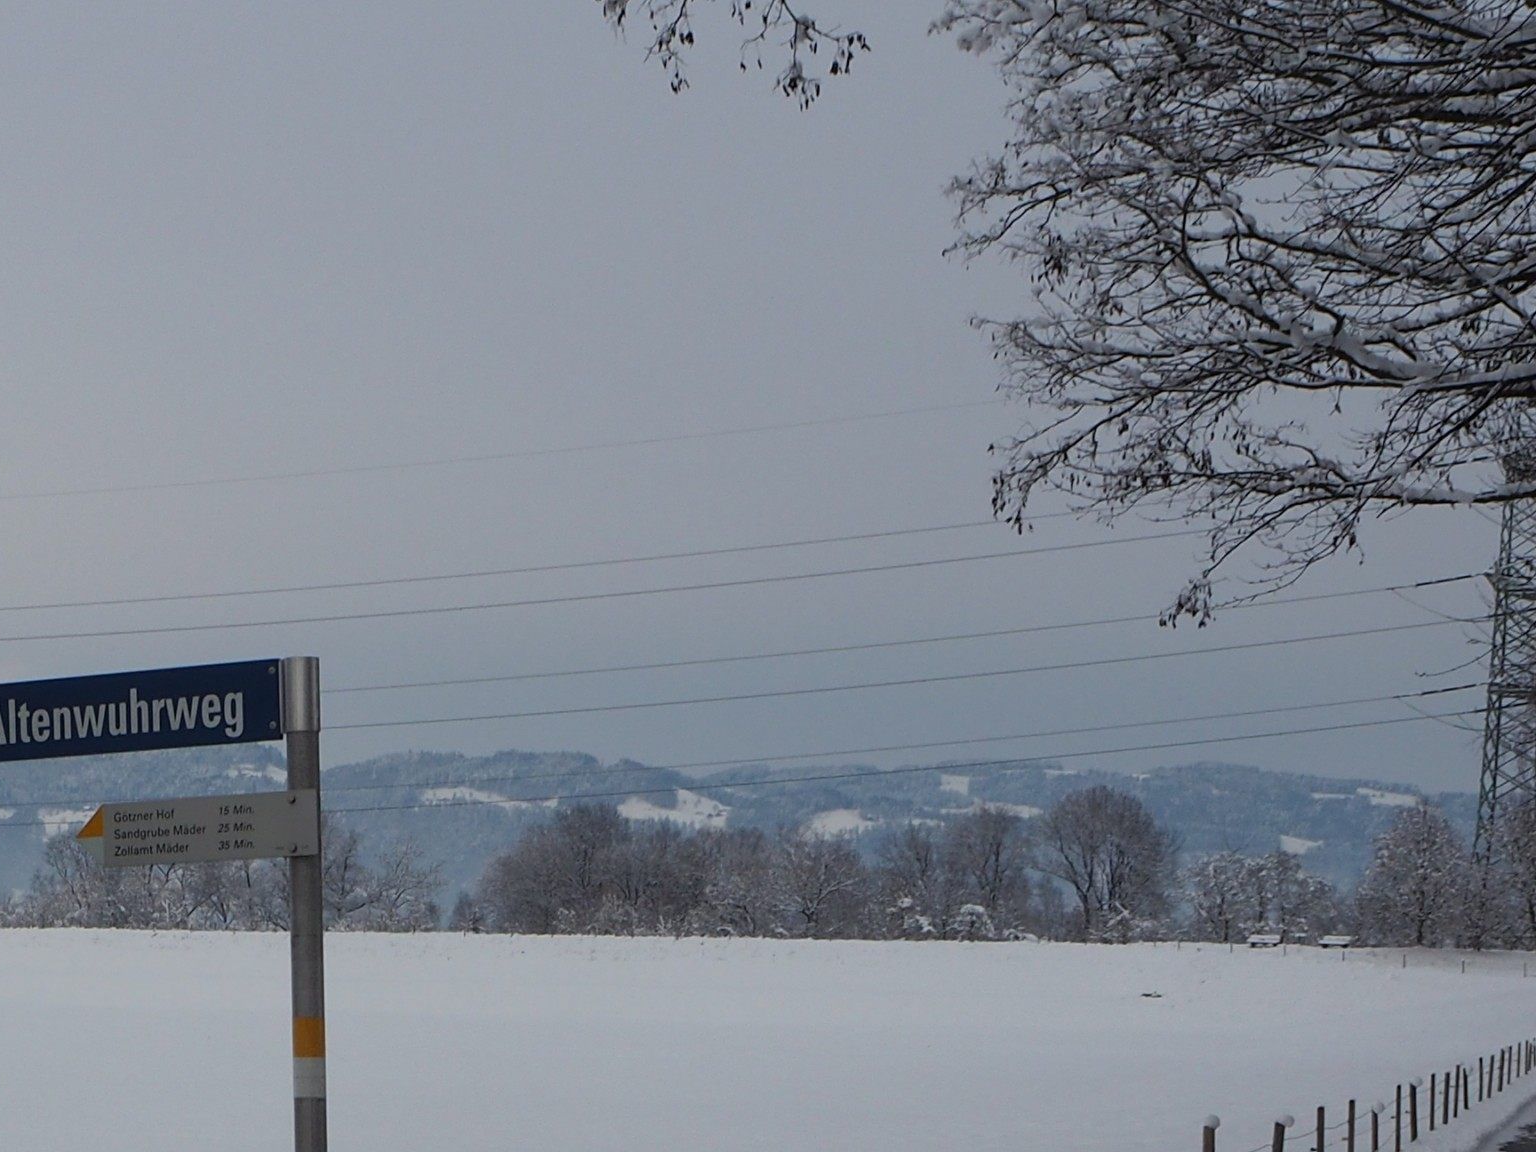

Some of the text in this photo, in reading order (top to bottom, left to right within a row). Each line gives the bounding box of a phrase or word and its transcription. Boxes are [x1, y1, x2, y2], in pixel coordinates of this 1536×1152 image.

[156, 808, 175, 819] Hof
[219, 806, 230, 815] 15
[233, 805, 255, 814] Min.
[114, 827, 170, 840] Sandgrube
[217, 823, 230, 833] 25
[233, 822, 255, 831] Min.
[114, 845, 153, 857] Zollamt
[218, 841, 230, 851] 35
[233, 839, 255, 849] Min.
